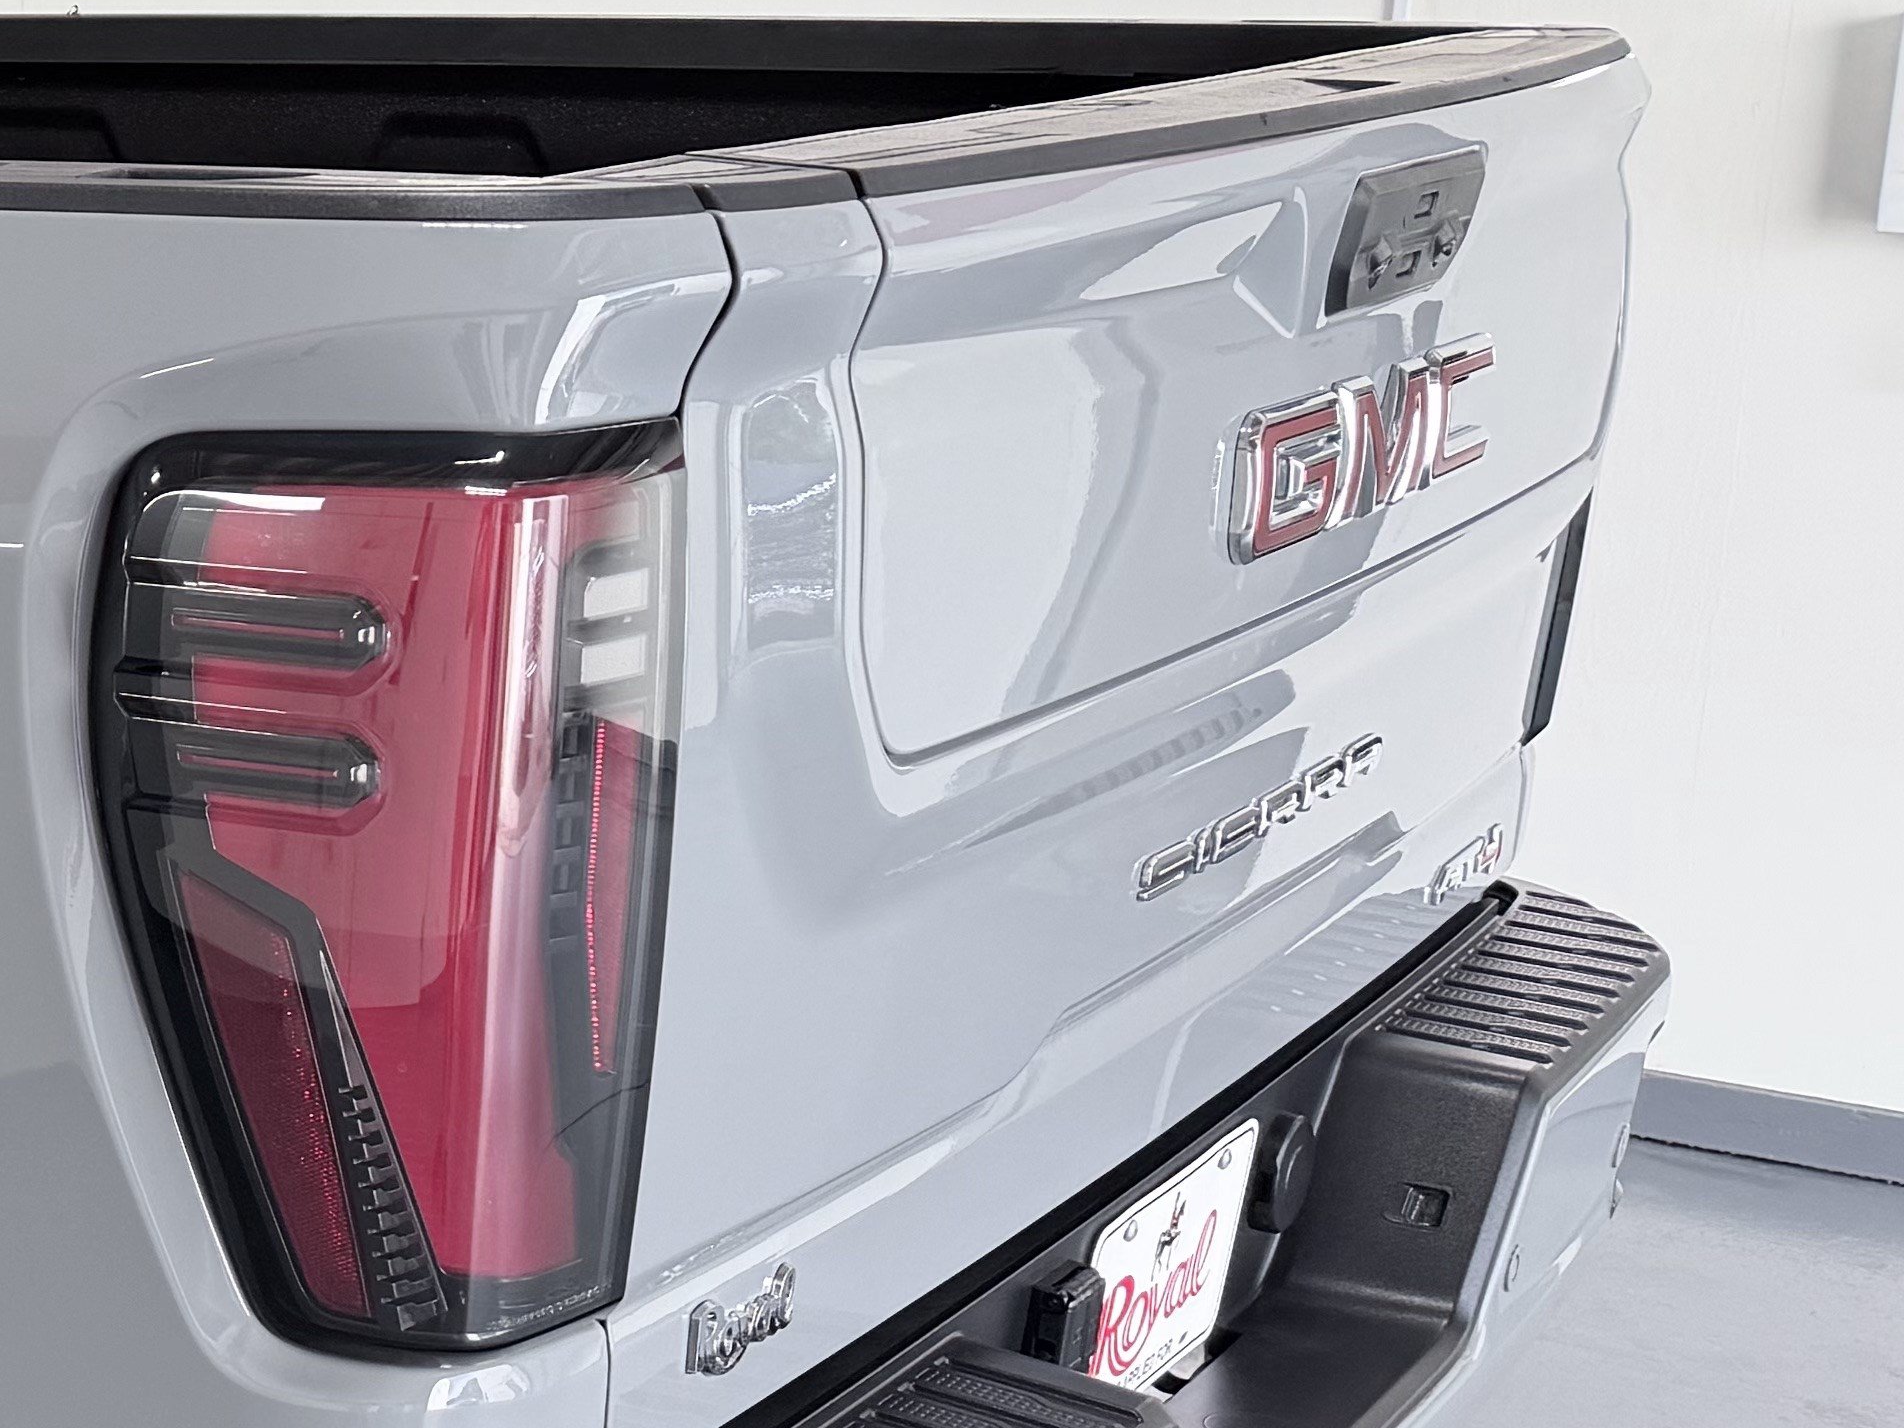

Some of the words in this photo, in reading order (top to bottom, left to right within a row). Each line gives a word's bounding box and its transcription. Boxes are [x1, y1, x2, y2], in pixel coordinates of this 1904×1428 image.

[1218, 332, 1497, 565] GMC
[1132, 732, 1384, 902] SIERRA
[684, 1261, 796, 1376] Royal
[1088, 1209, 1217, 1378] Royal
